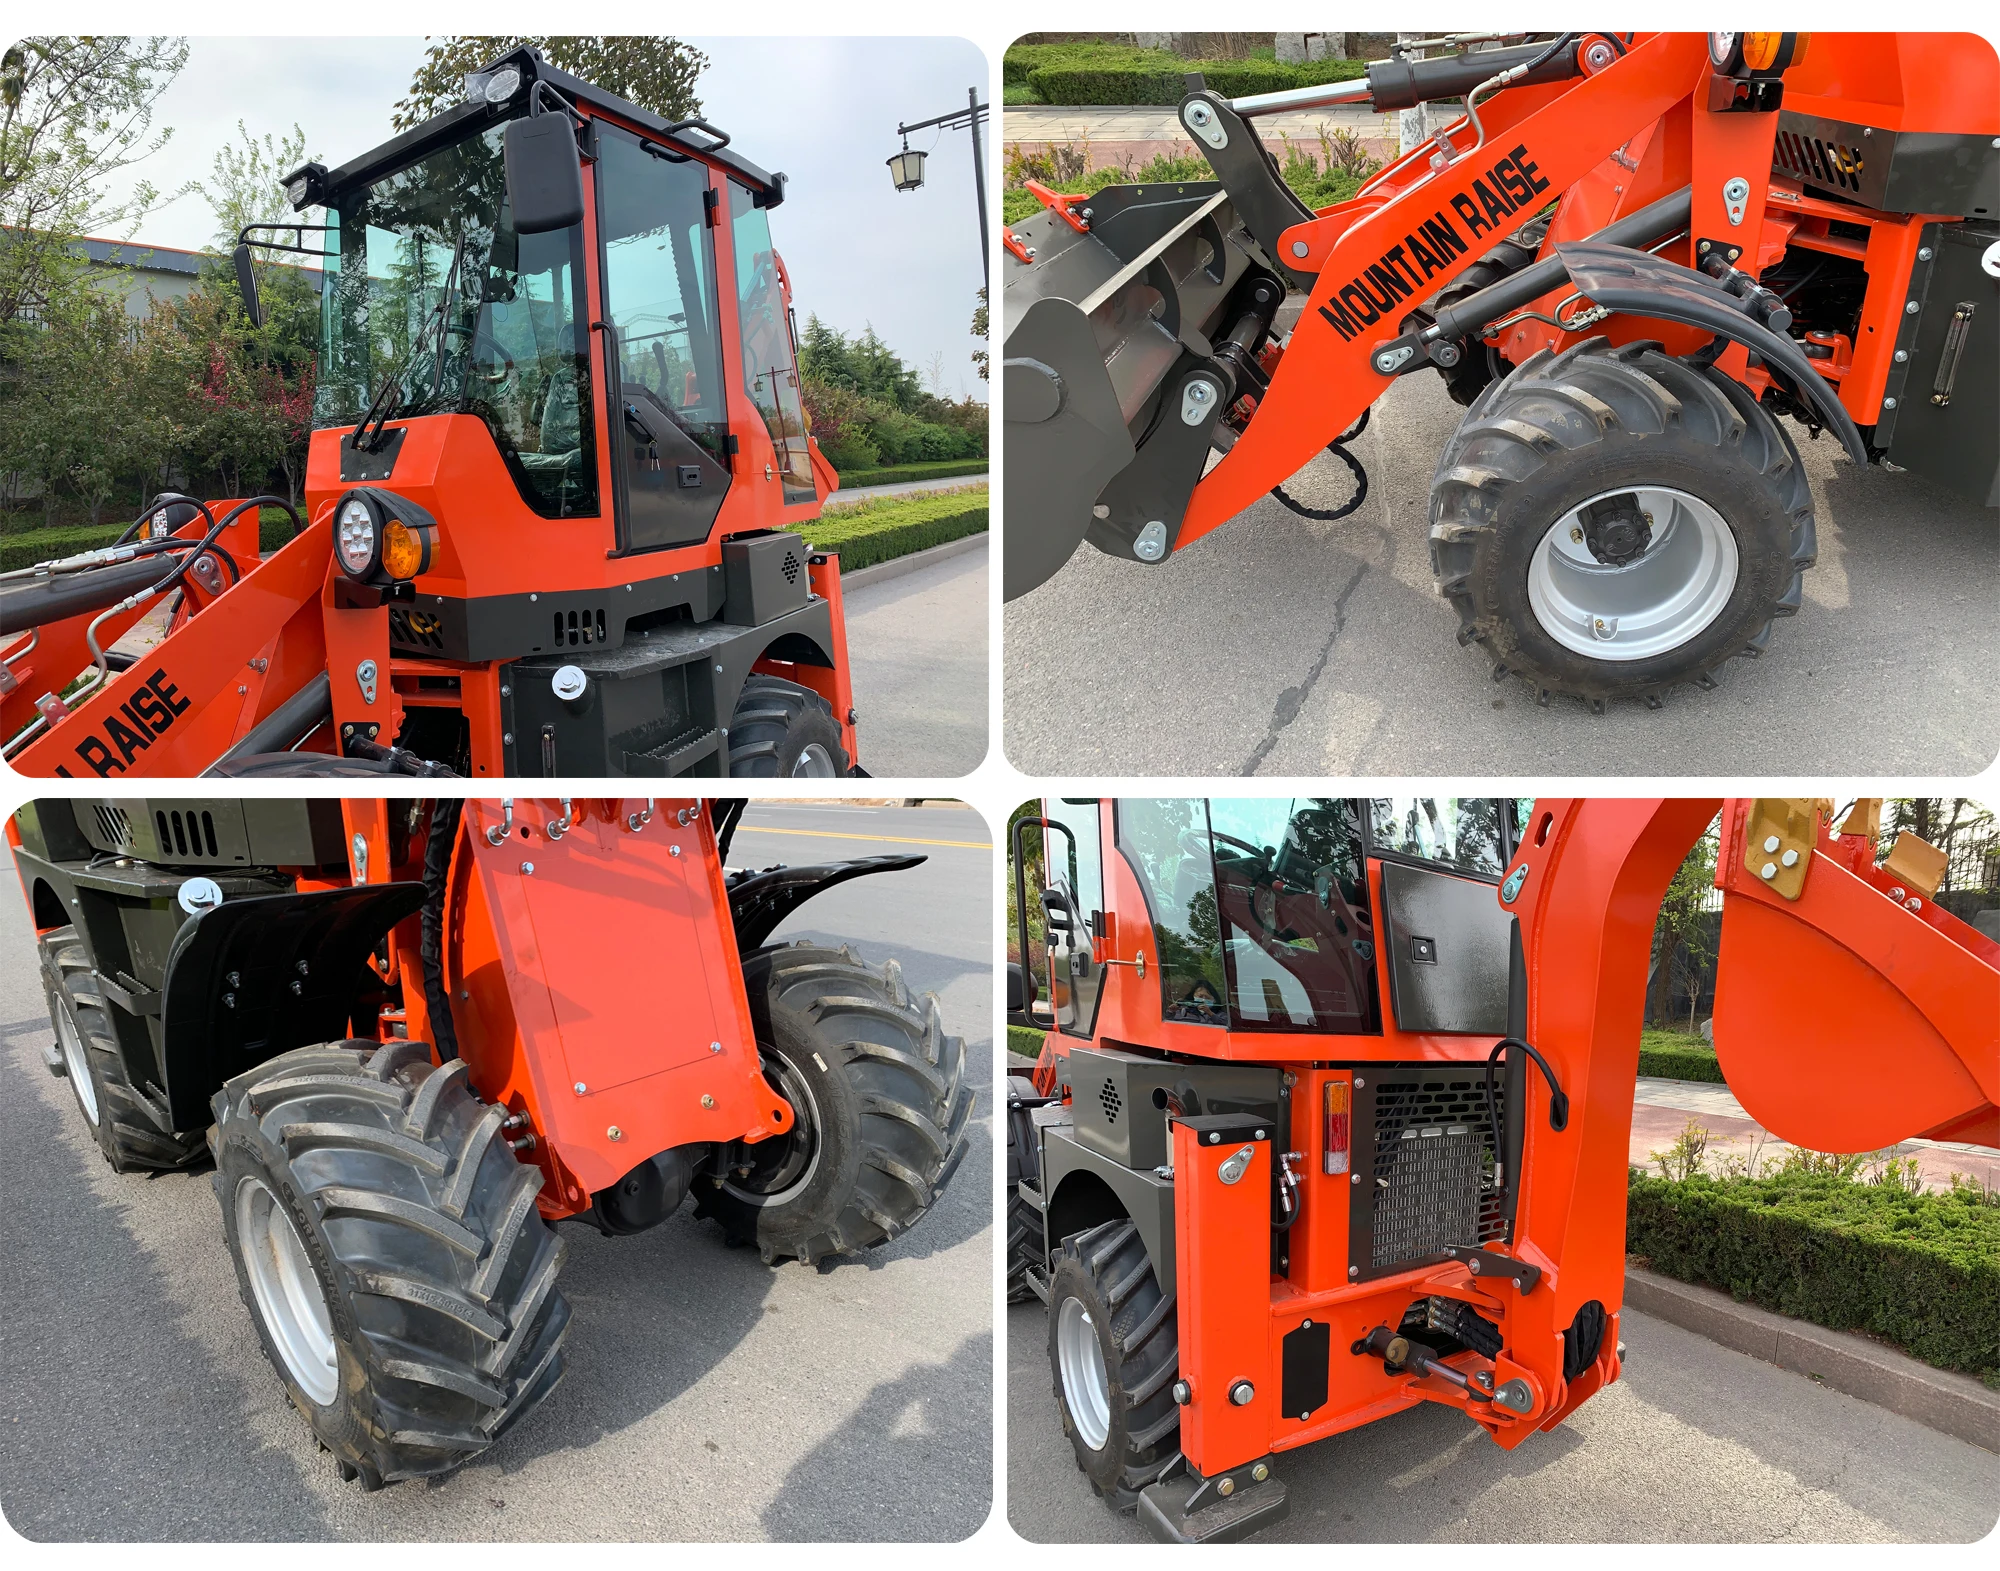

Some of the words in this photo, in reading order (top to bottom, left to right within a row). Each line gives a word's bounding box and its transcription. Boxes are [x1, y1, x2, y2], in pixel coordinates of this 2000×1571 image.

[1318, 211, 1470, 343] MOUNTAIN
[1450, 143, 1551, 240] RAISE
[74, 667, 192, 778] RAISE
